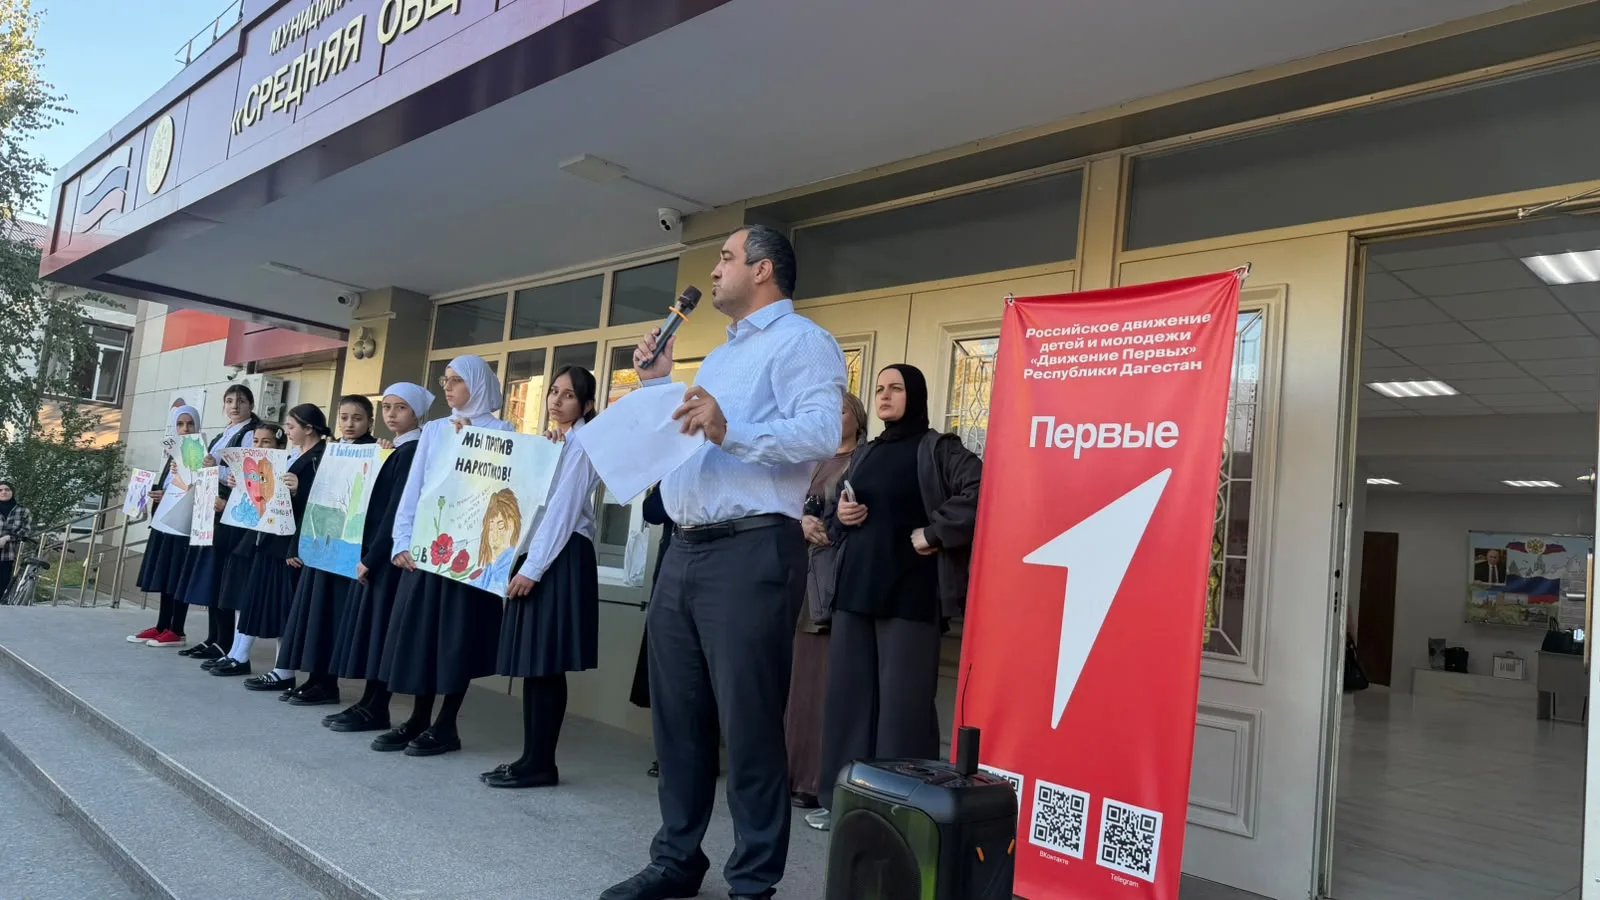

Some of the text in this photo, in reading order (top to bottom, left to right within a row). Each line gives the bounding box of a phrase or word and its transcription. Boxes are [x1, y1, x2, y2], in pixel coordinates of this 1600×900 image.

[231, 13, 365, 135] «СРЕДНЯЯ
[1025, 313, 1212, 338] Российское движение
[1039, 331, 1192, 353] детей и молодежи
[1030, 346, 1197, 367] «Движение Первых»
[1023, 361, 1203, 380] Республики Дагестан
[461, 431, 483, 449] МЫ
[1029, 415, 1180, 460] Первые
[454, 456, 512, 483] НАРКОТИКОВ!
[1110, 872, 1139, 888] Telegram
